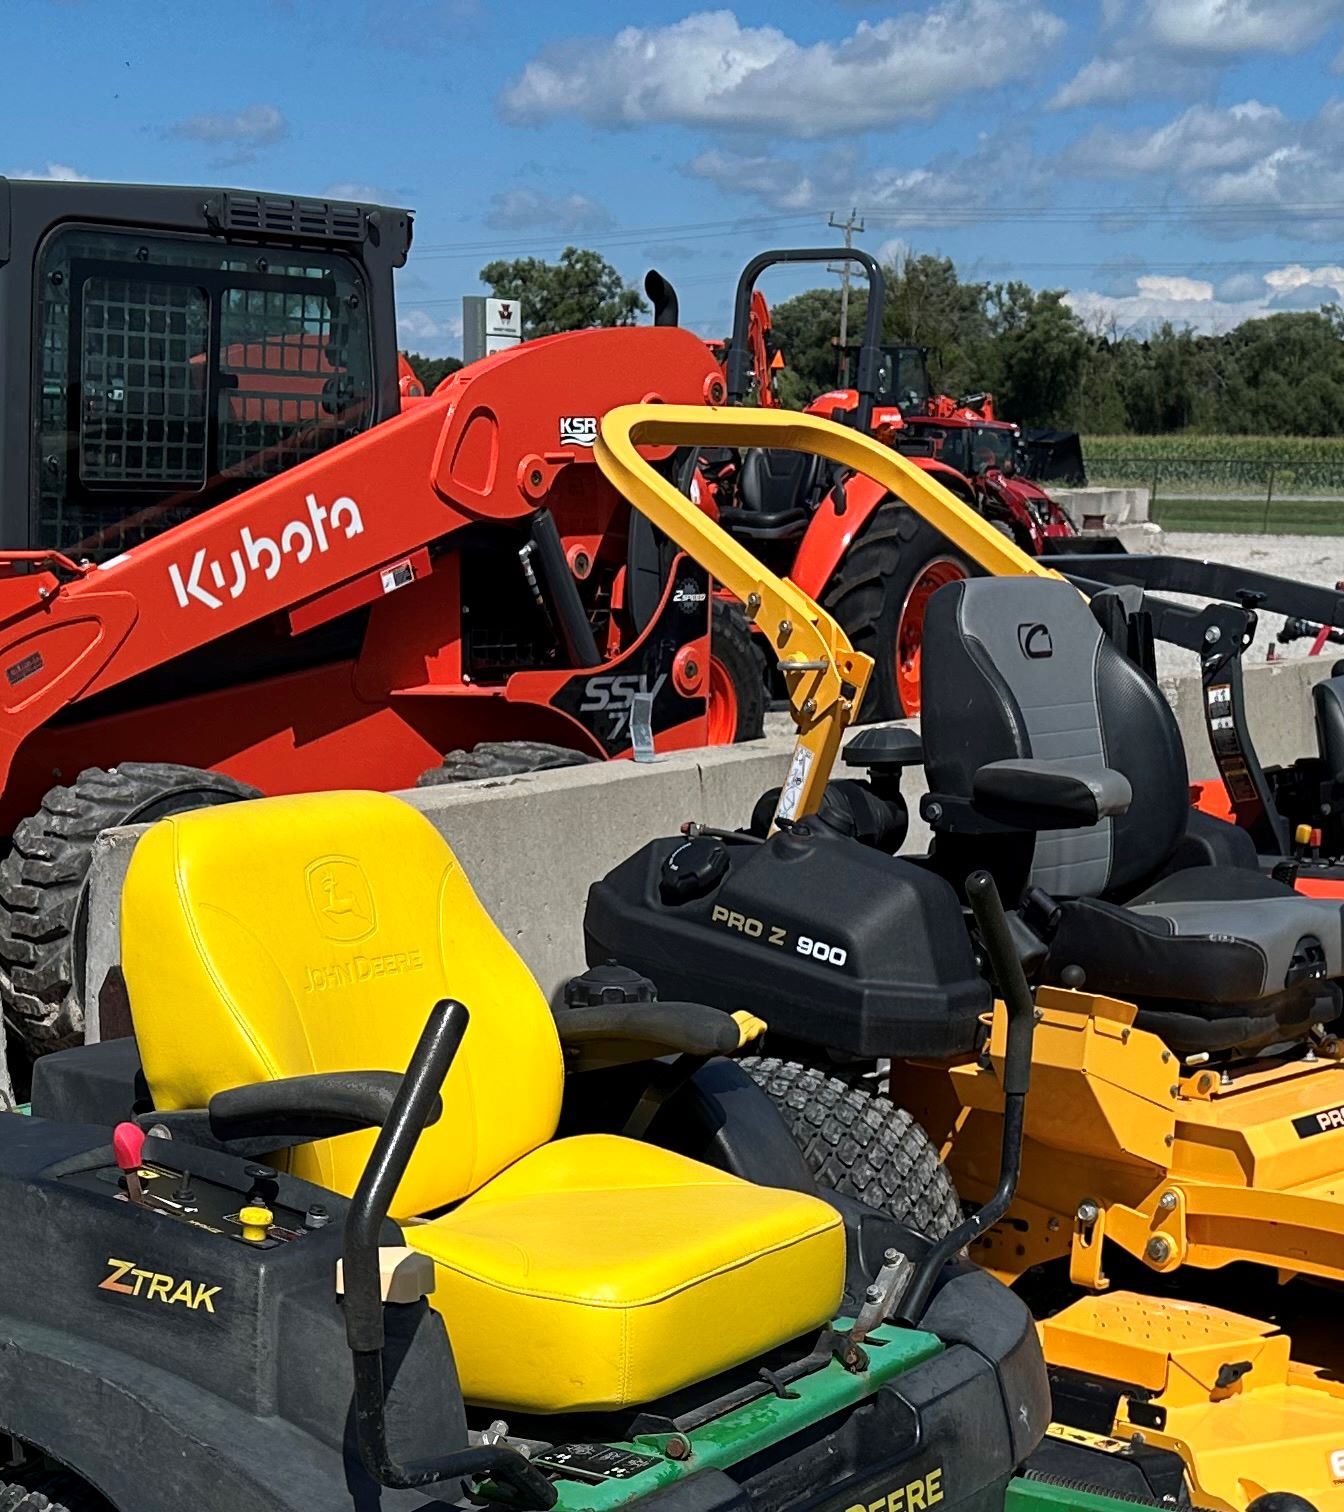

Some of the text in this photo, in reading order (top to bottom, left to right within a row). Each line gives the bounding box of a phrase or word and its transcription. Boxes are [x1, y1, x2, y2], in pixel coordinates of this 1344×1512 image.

[560, 417, 597, 434] KSR
[167, 492, 365, 609] Kubota
[580, 673, 668, 712] SSV
[607, 711, 633, 741] 7
[712, 903, 848, 968] PRO Z 900
[303, 949, 423, 993] JOHN DEERE
[98, 1258, 223, 1314] ZTRAK
